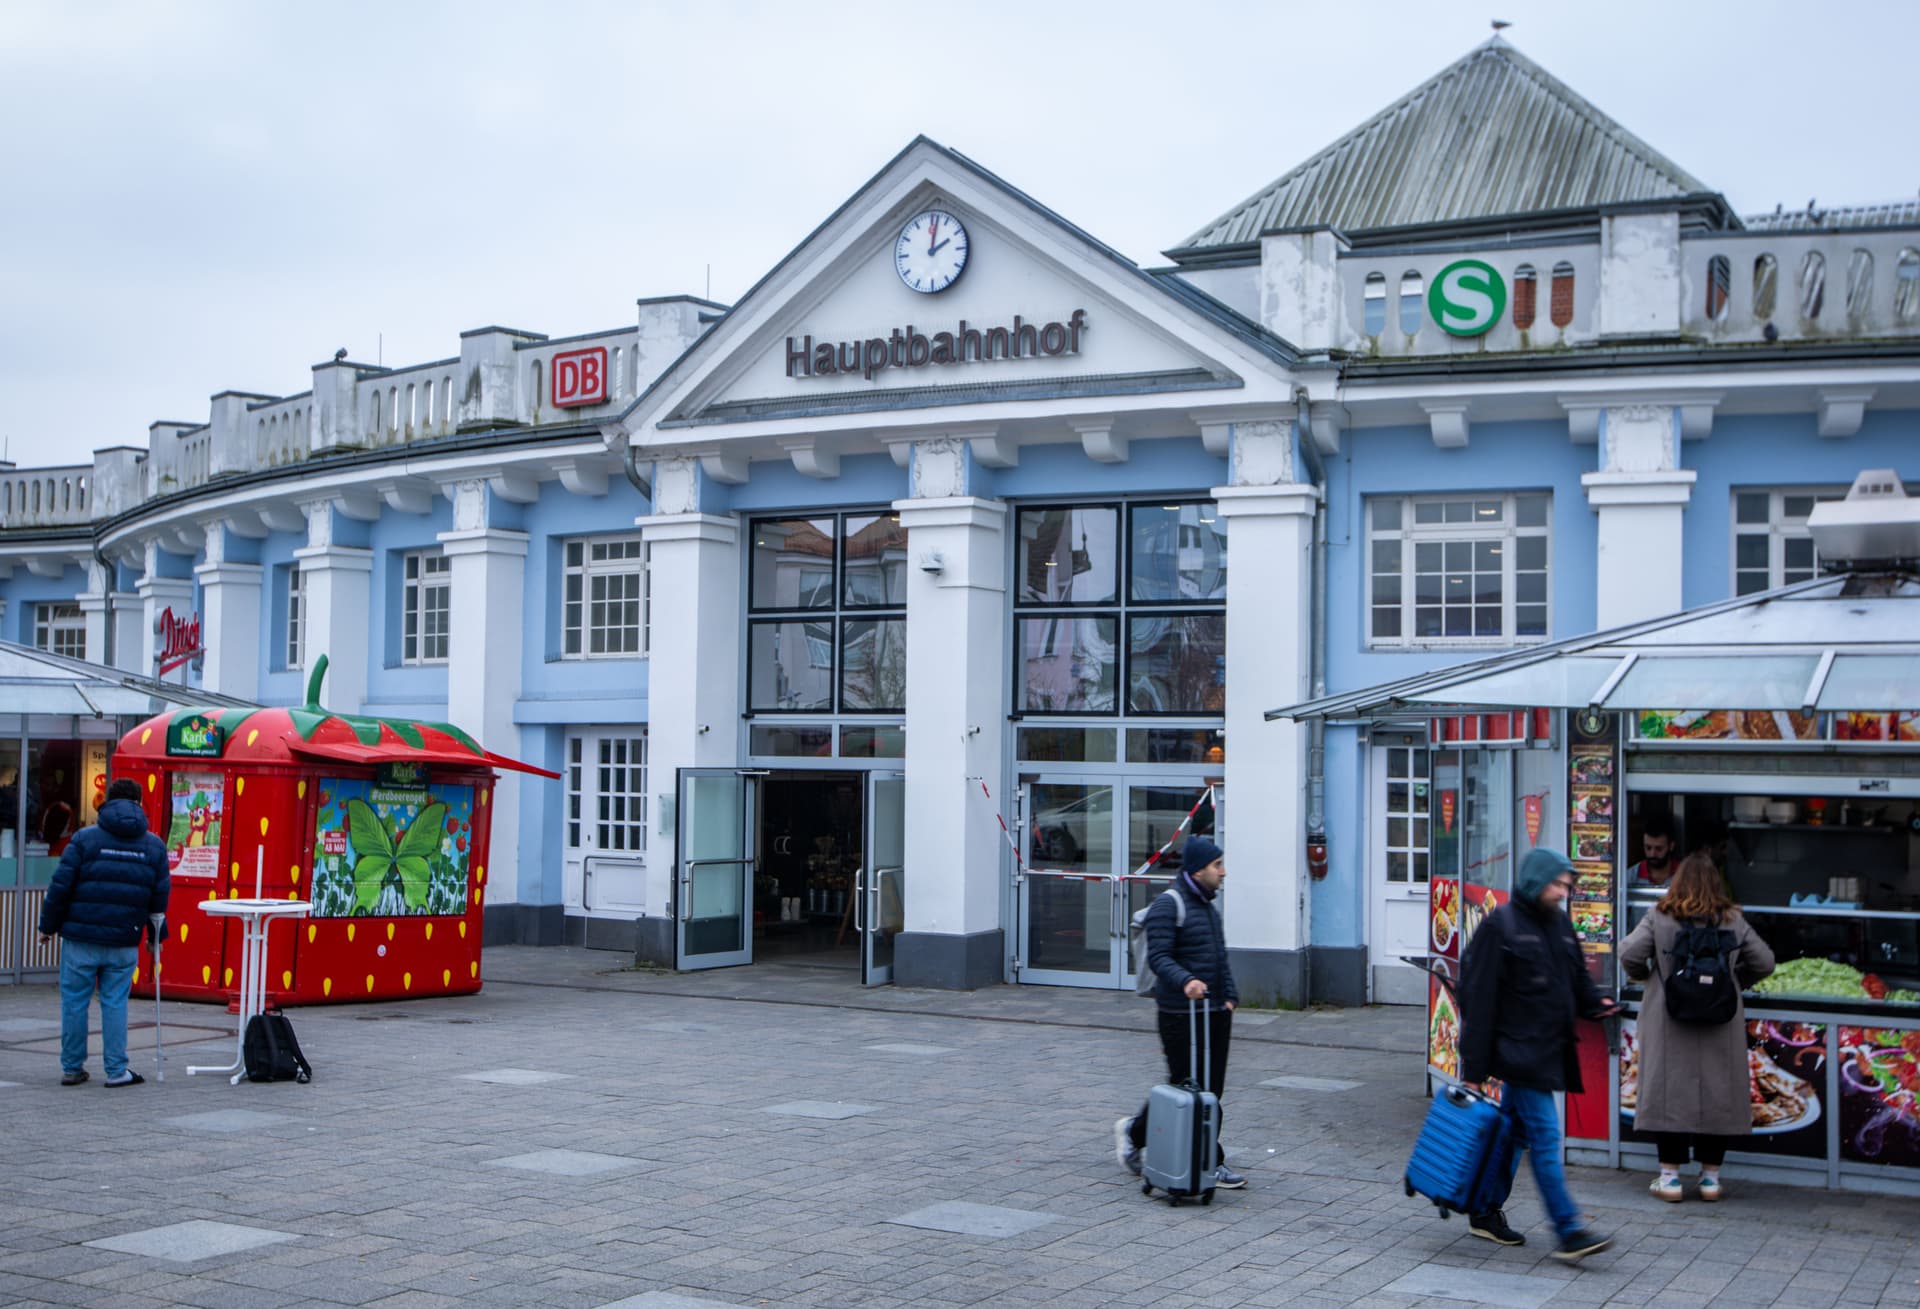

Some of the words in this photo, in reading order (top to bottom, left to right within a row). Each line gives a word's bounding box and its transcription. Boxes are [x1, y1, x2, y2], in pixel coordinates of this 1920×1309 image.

[1441, 266, 1495, 331] S
[785, 309, 1088, 380] Hauptbahnhof
[559, 357, 600, 398] DB
[160, 606, 199, 661] Ditsch
[182, 730, 207, 744] Karls
